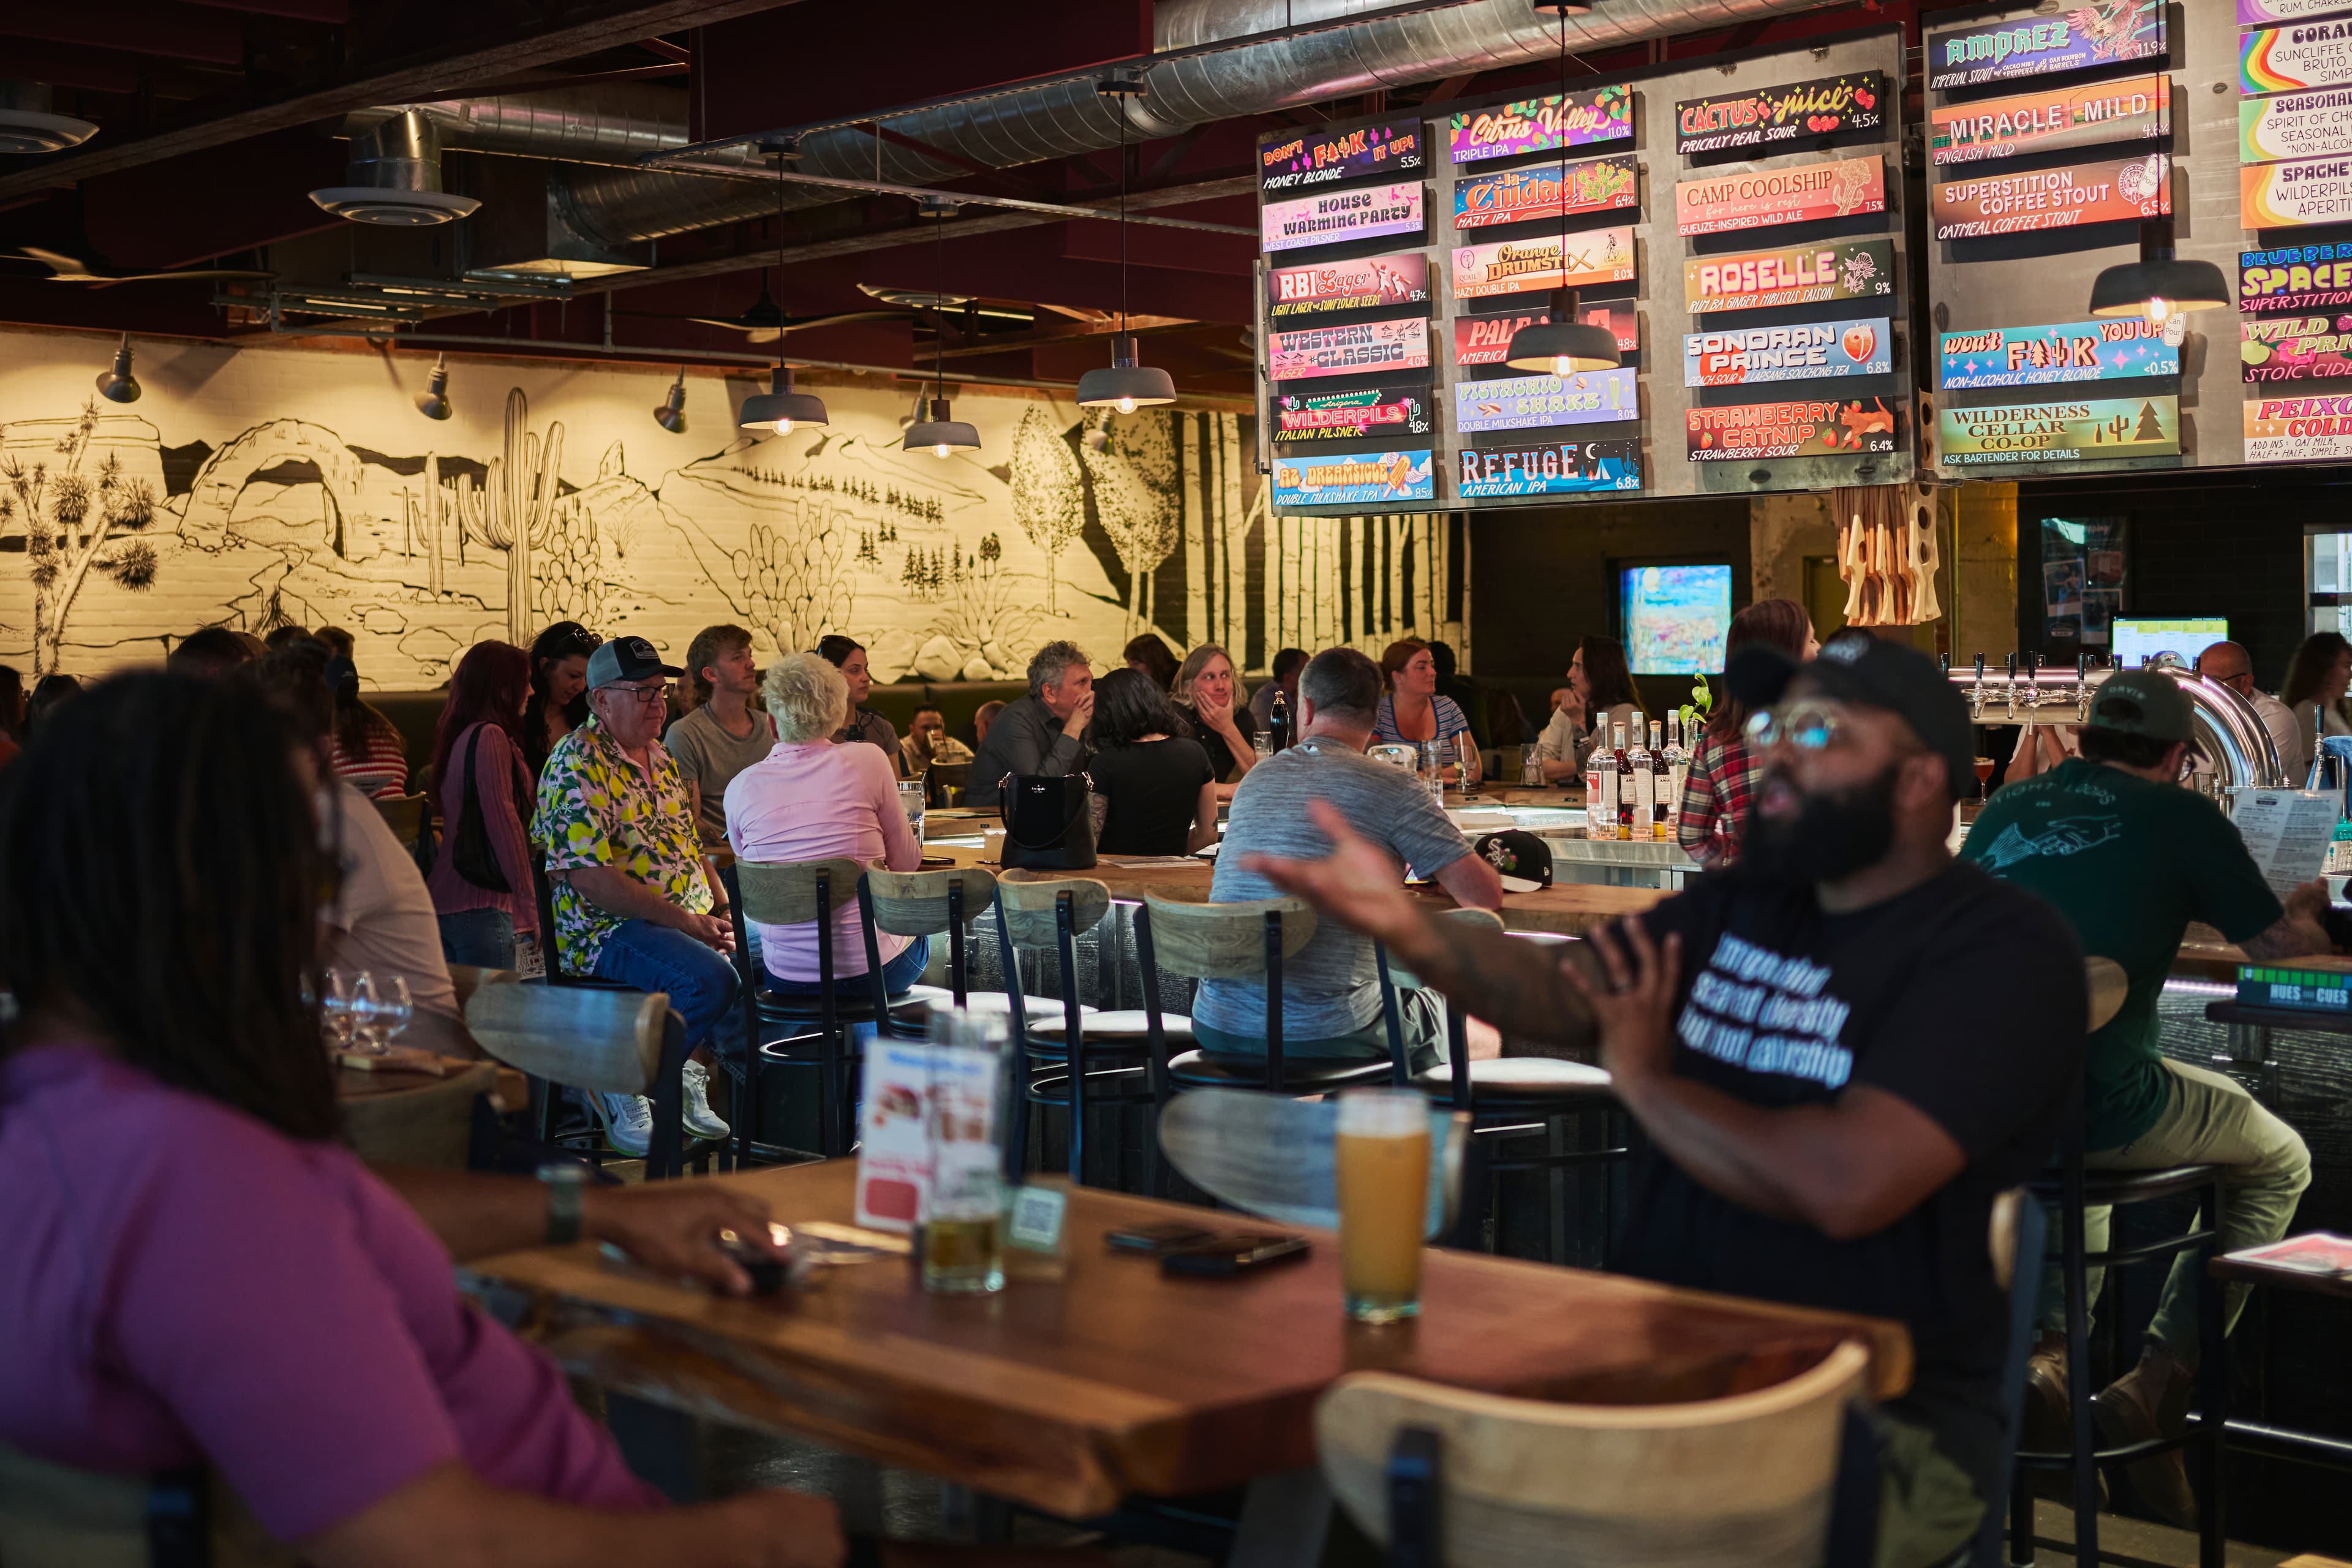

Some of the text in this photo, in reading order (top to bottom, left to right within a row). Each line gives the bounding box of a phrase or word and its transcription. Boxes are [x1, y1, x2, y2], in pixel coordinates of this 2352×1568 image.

[2062, 53, 2086, 61] BOURBON
[2137, 40, 2166, 57] 11.9%
[2275, 43, 2343, 62] SUNCLIFFE
[2049, 60, 2079, 70] BARRELS
[2304, 56, 2346, 71] BRUTO
[1931, 67, 1994, 89] IMPERIAL STOUT
[1681, 86, 1848, 136] CACTUS juice
[1950, 94, 2147, 140] MIRACLE MILD
[1470, 98, 1611, 146] Citrus Valley
[1852, 114, 1879, 128] 4.5%
[2267, 113, 2326, 130] SPIRIT OF
[1608, 126, 1629, 138] 11.0%
[1680, 125, 1796, 153] PRICKLY PEAR SOUR
[2281, 126, 2346, 142] SEASONAL
[1264, 135, 1415, 165] DON'T IT UP!
[1454, 144, 1509, 161] TRIPLE IPA
[1934, 143, 2015, 165] ENGLISH MILD
[1401, 156, 1420, 168] 5.5%
[1263, 167, 1344, 189] HONEY BLONDE
[1466, 173, 1577, 213] Ciudad
[1687, 170, 1833, 206] CAMP COOLSHIP
[1945, 171, 2072, 203] SUPERSTITION
[1318, 194, 1371, 213] HOUSE
[1616, 195, 1634, 207] 6.4%
[1706, 195, 1801, 219] for here is rest
[1865, 201, 1883, 211] 7.5%
[1980, 184, 2110, 215] COFFEE STOUT
[2141, 200, 2169, 216] 6.5%
[1284, 205, 1411, 236] WARMING PARTY
[1406, 222, 1421, 230] 5.3%
[1457, 212, 1510, 228] HAZY IPA
[1679, 211, 1803, 235] GUEUZE-INSPIRED WILD ALE
[1939, 209, 2082, 239] OATMEAL COFFEE STOUT
[1265, 233, 1340, 251] WEST COAST PILSNER
[1498, 244, 1561, 263] Orange
[1613, 268, 1634, 280] 8.0%
[1700, 252, 1836, 295] ROSELLE
[1278, 270, 1370, 301] RBI Lager
[1455, 282, 1520, 298] HAZY DOUBLE IPA
[1875, 282, 1890, 294] 9%
[1410, 290, 1426, 301] 4.7%
[1688, 287, 1834, 313] RUM BA GINGER HIBISCUS SAISON
[1272, 295, 1381, 316] LIGHT LAGER SUNFLOWER SEEDS
[2098, 322, 2135, 342] YOU
[2166, 328, 2180, 336] Pour
[2246, 318, 2329, 339] WILD
[1280, 325, 1374, 352] WESTERN
[1618, 339, 1636, 350] 4.8%
[1687, 325, 1836, 356] SONORAN
[1317, 343, 1405, 368] CLASSIC
[1408, 356, 1428, 366] 4.0%
[1710, 347, 1826, 372] PRINCE
[1272, 368, 1306, 379] LAGER
[1689, 365, 1849, 385] PEACH SOUR LAPSANG SOUCHONG TEA
[1866, 362, 1890, 374] 6.8%
[2144, 361, 2177, 375] <0.5%
[2245, 365, 2307, 382] STOIC
[1944, 367, 2105, 389] NON-ALCOHOLIC HONEY BLONDE
[1459, 376, 1563, 401] PISTACHIO
[1517, 392, 1601, 415] SHAKE
[1287, 407, 1400, 428] WILDERPILS
[1618, 409, 1635, 420] 8.0%
[1689, 402, 1839, 430] STRAWBERRY
[1953, 404, 2090, 424] WILDERNESS
[1409, 421, 1428, 434] 4.8%
[1458, 416, 1553, 431] DOUBLE MILKSHAKE IPA
[1968, 421, 2067, 438] CELLAR
[2289, 418, 2352, 437] COLD
[1275, 426, 1362, 441] ITALIAN PILSNER
[1723, 424, 1815, 448] CATNIP
[1870, 440, 1893, 451] 6.4%
[1980, 435, 2051, 450] CO-OP
[2251, 441, 2269, 450] ADD
[2313, 437, 2336, 447] MILK,
[1690, 445, 1799, 461] STRAWBERRY SOUR
[1944, 449, 2080, 464] ASK BARTENDER FOR DETAILS
[2249, 447, 2340, 459] HALF HALF, SIMPLE
[1461, 444, 1578, 484] REFUGE
[1279, 462, 1388, 488] AZ DREAMSICLE
[1616, 477, 1639, 489] 6.8%
[1415, 488, 1431, 499] 8.5%
[1463, 480, 1547, 496] AMERICAN IPA
[1276, 490, 1378, 504] DOUBLE MILKSHAKE IPA
[2108, 685, 2147, 699] ORVIS
[2271, 984, 2301, 1000] HUES
[2316, 987, 2348, 1004] CUES
